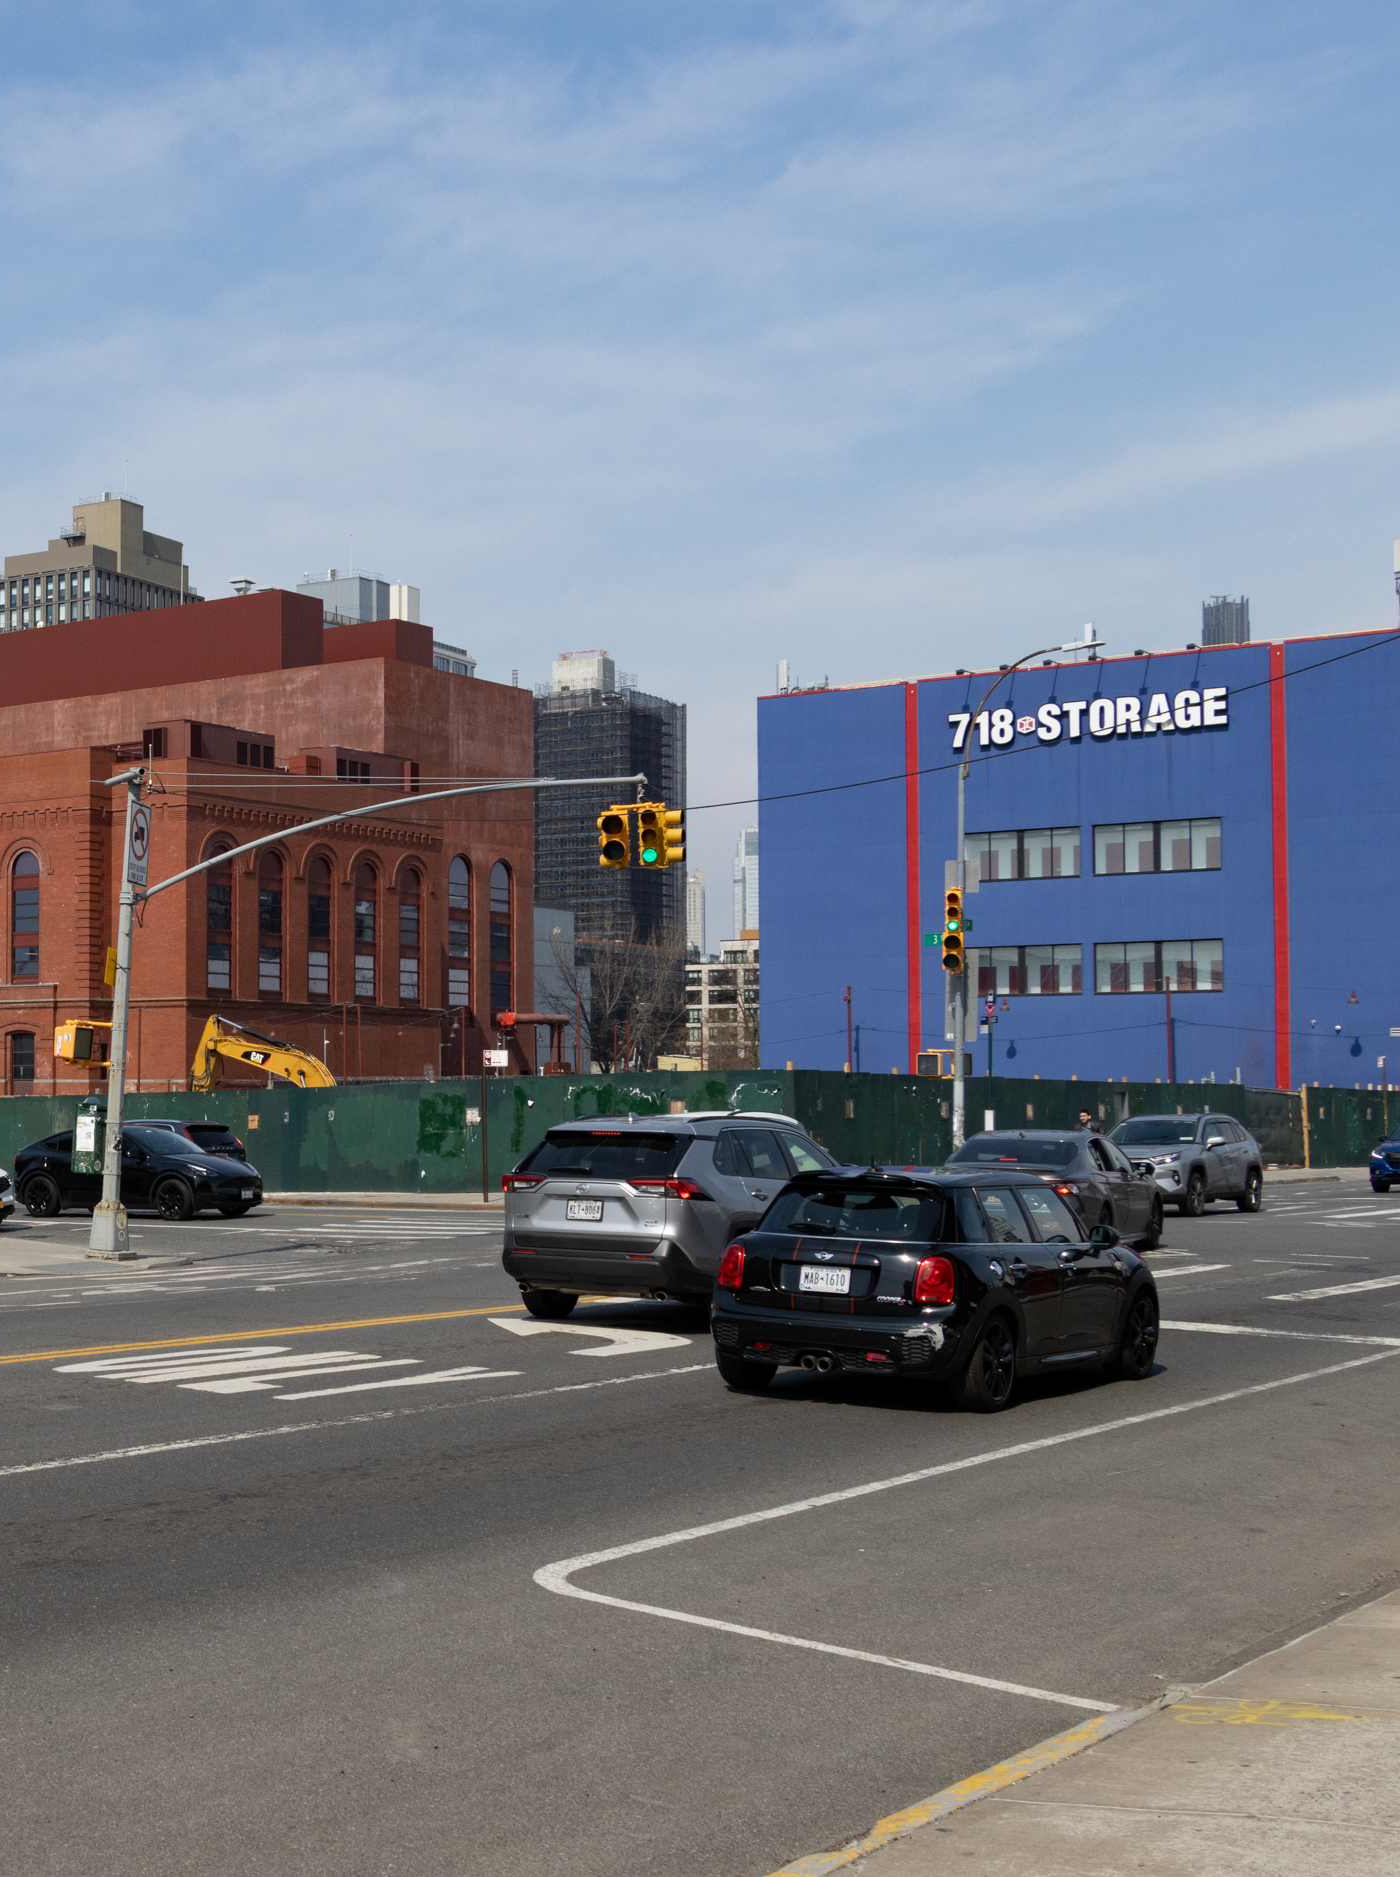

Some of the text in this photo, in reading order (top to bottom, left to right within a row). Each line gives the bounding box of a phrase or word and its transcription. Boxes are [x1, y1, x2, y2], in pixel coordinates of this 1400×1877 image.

[948, 686, 1229, 749] 718 STORAGE
[933, 934, 938, 945] 3
[250, 1051, 264, 1064] CAT
